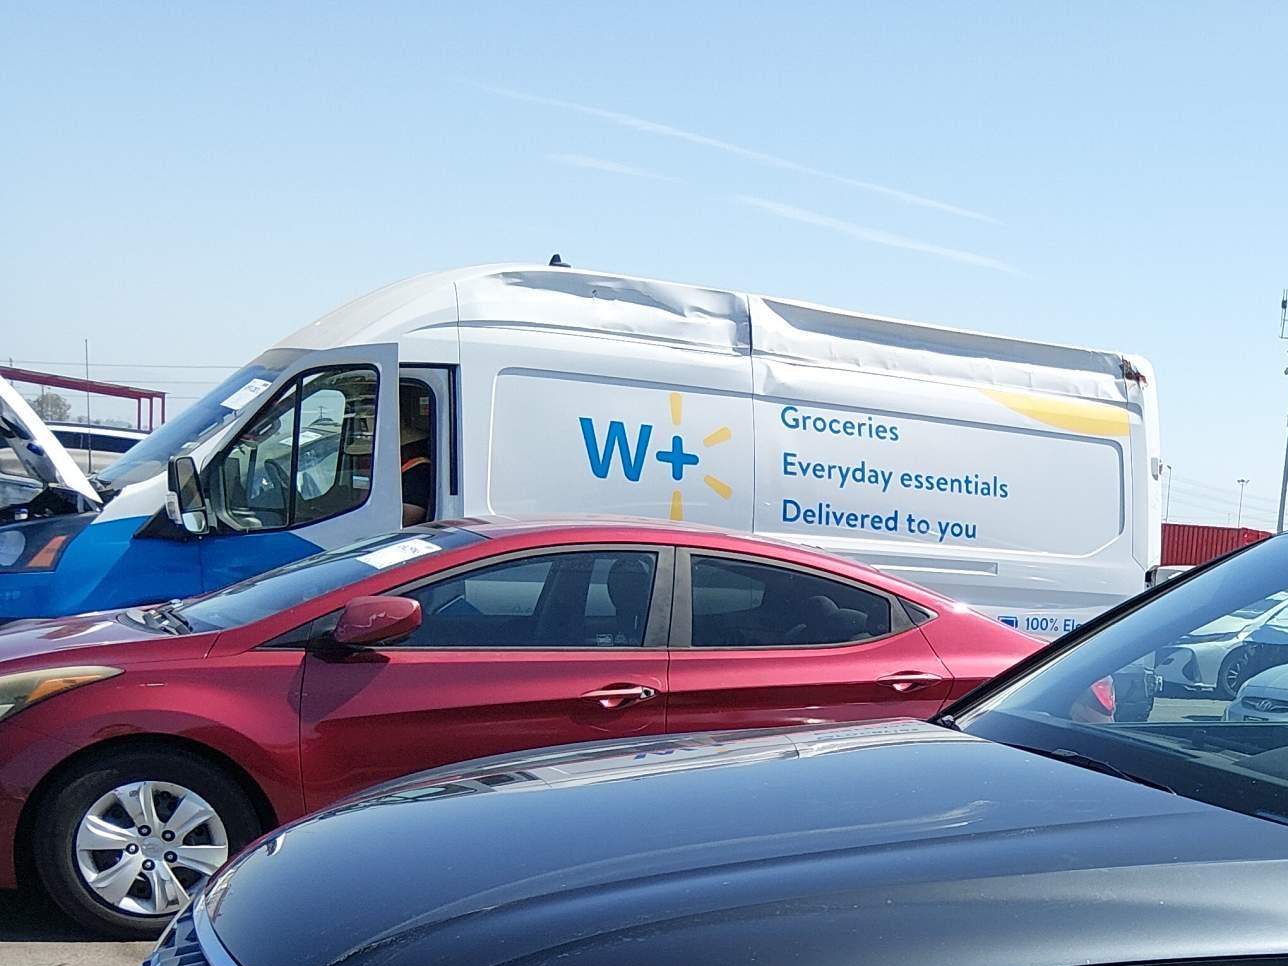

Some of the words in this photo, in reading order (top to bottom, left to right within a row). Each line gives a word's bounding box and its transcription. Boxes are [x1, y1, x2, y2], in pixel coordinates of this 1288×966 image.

[780, 406, 900, 442] Groceries
[579, 416, 699, 483] W+
[782, 453, 893, 492] Everyday
[900, 470, 1009, 499] essentials
[781, 500, 898, 533] Delivered
[906, 512, 931, 535] to
[937, 519, 977, 541] you
[1026, 617, 1059, 632] 100%
